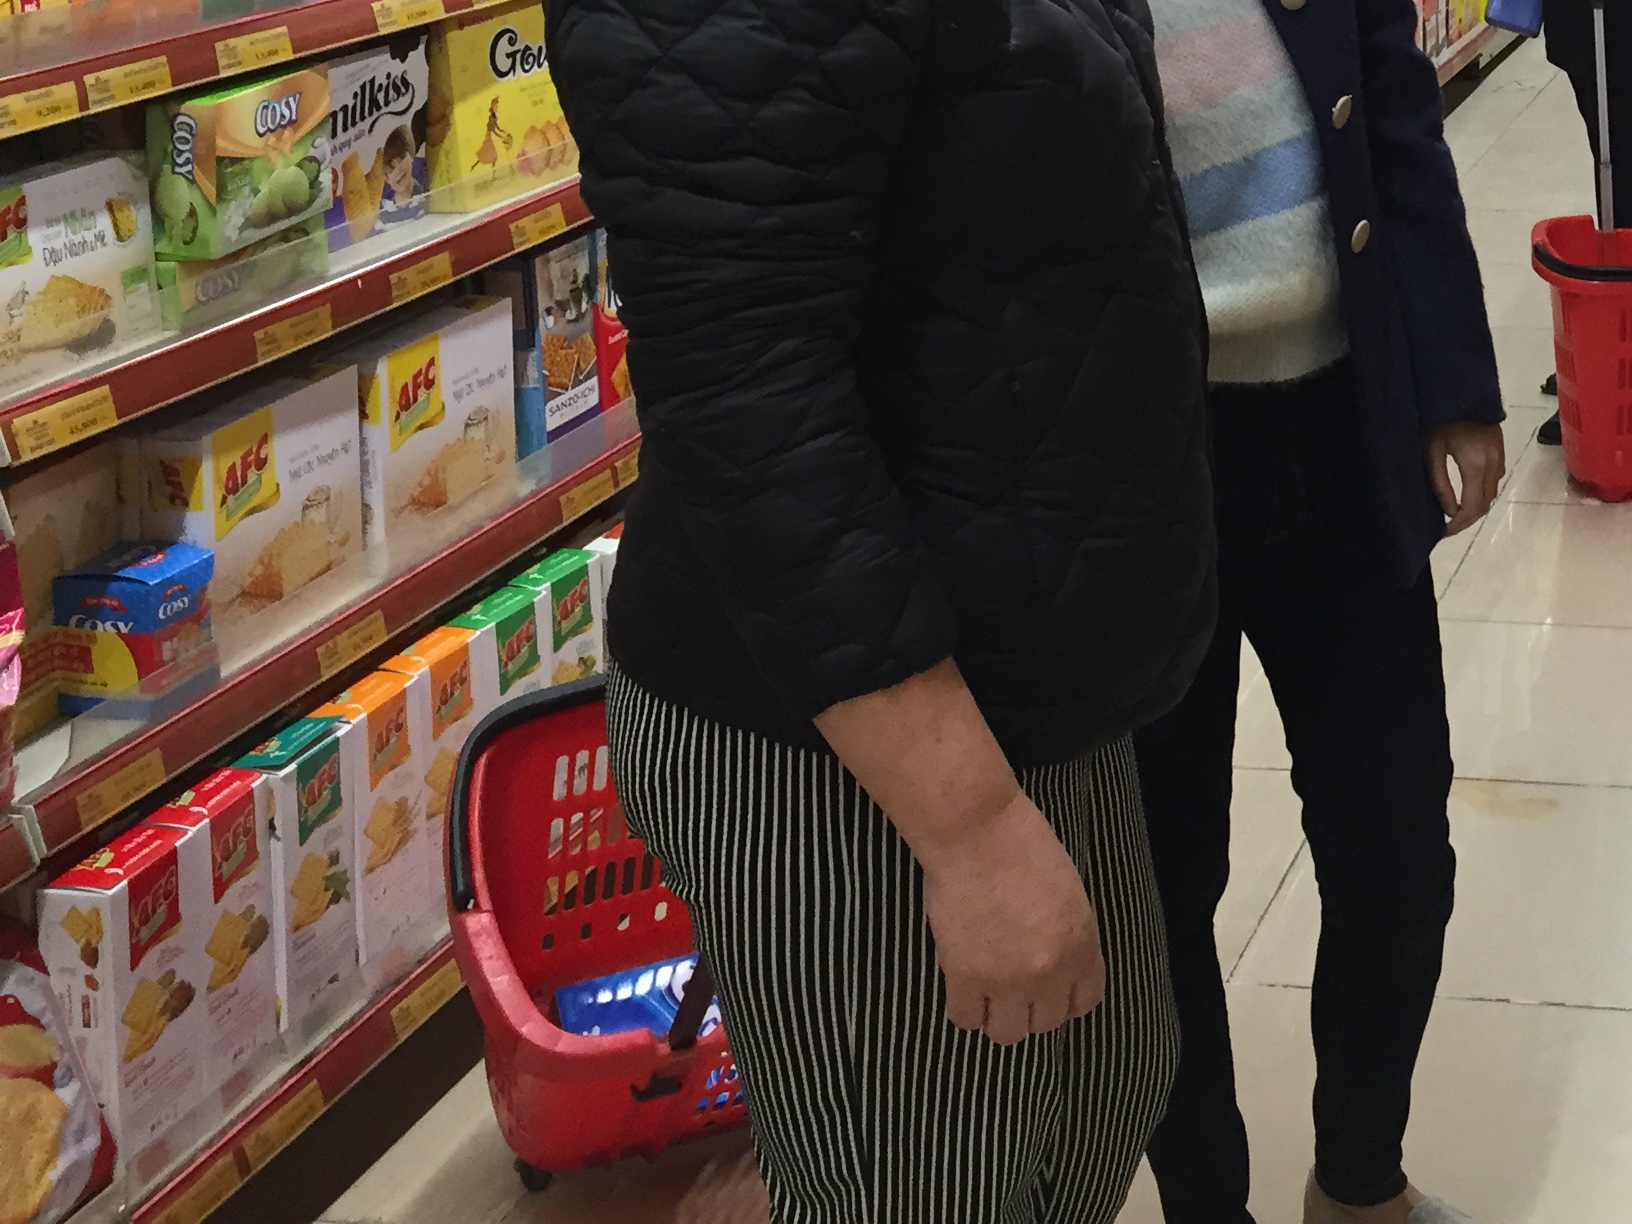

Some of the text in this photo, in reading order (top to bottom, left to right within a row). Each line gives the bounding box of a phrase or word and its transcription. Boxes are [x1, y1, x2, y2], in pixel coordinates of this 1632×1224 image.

[489, 27, 549, 81] Gou
[255, 91, 302, 137] COSY
[171, 112, 198, 181] COSY
[394, 354, 437, 424] AFC
[220, 431, 270, 509] AFC
[157, 594, 191, 620] COSY
